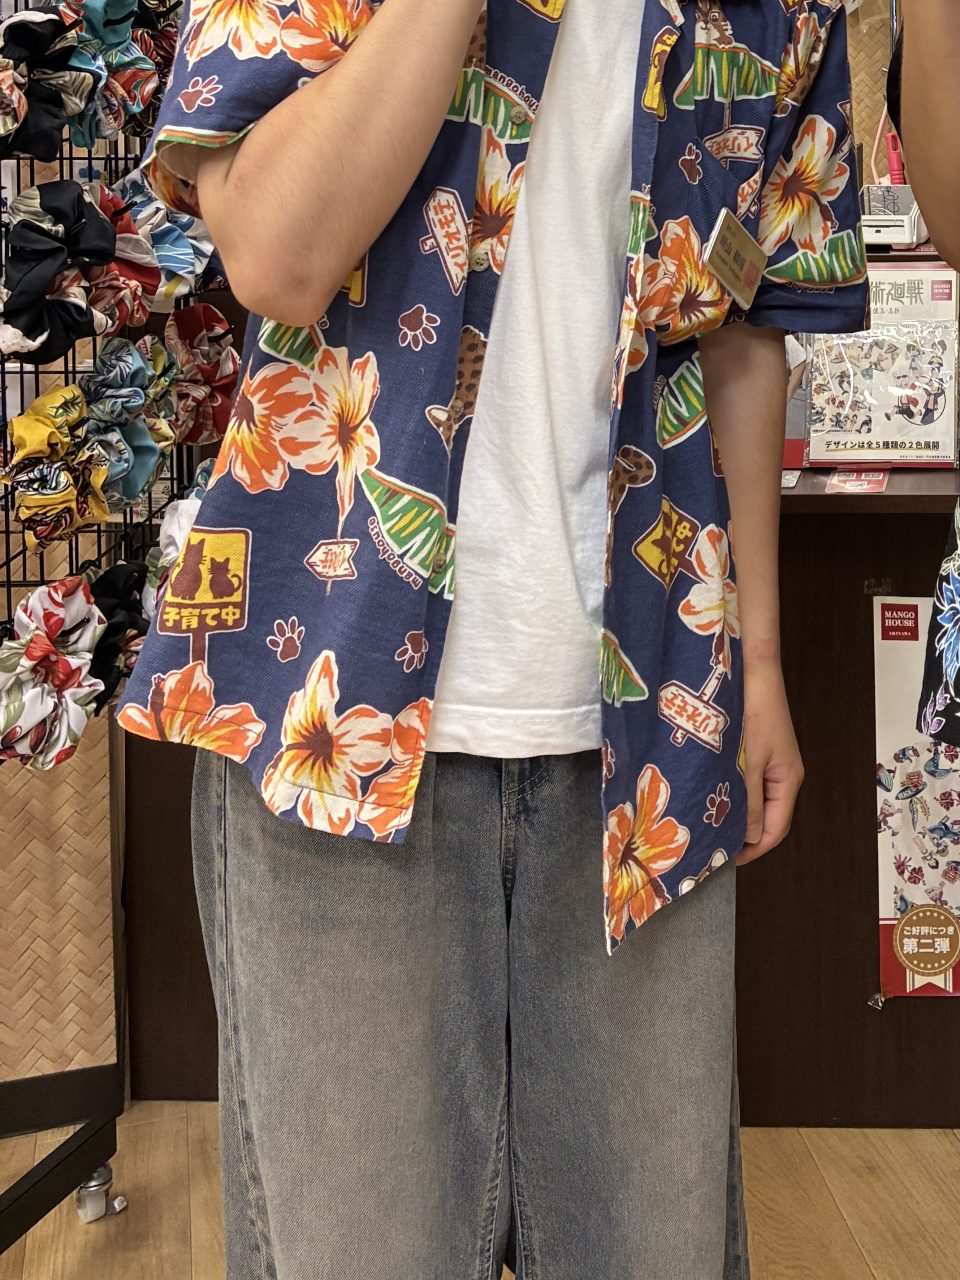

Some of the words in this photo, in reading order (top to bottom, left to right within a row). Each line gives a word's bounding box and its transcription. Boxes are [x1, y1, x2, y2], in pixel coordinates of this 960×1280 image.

[163, 605, 241, 630] 子育て中
[884, 610, 915, 618] MANGO
[904, 926, 954, 935] ご好評につき
[902, 937, 950, 954] 第二弾
